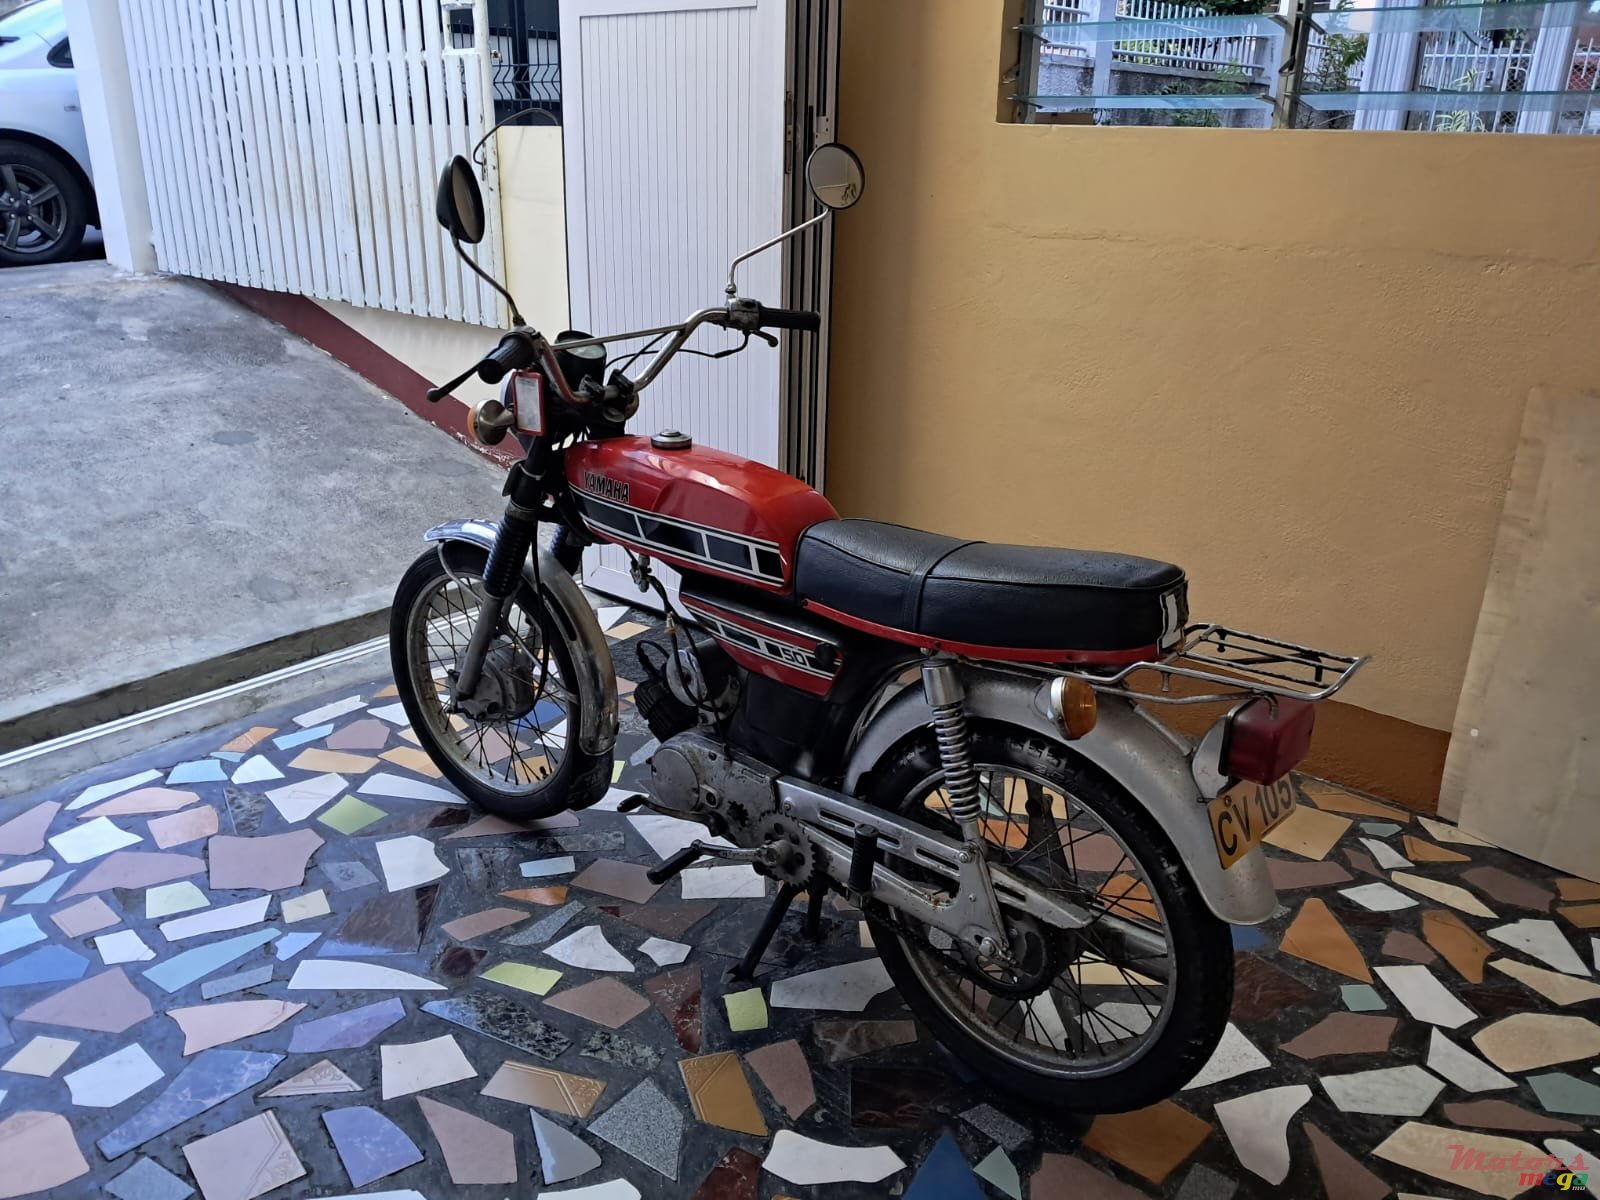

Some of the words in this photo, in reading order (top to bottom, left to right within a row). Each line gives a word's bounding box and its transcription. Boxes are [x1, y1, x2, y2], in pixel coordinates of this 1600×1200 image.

[583, 470, 630, 504] YAMAHA
[780, 647, 808, 666] 50
[1217, 794, 1251, 856] CV
[1254, 779, 1293, 827] 105
